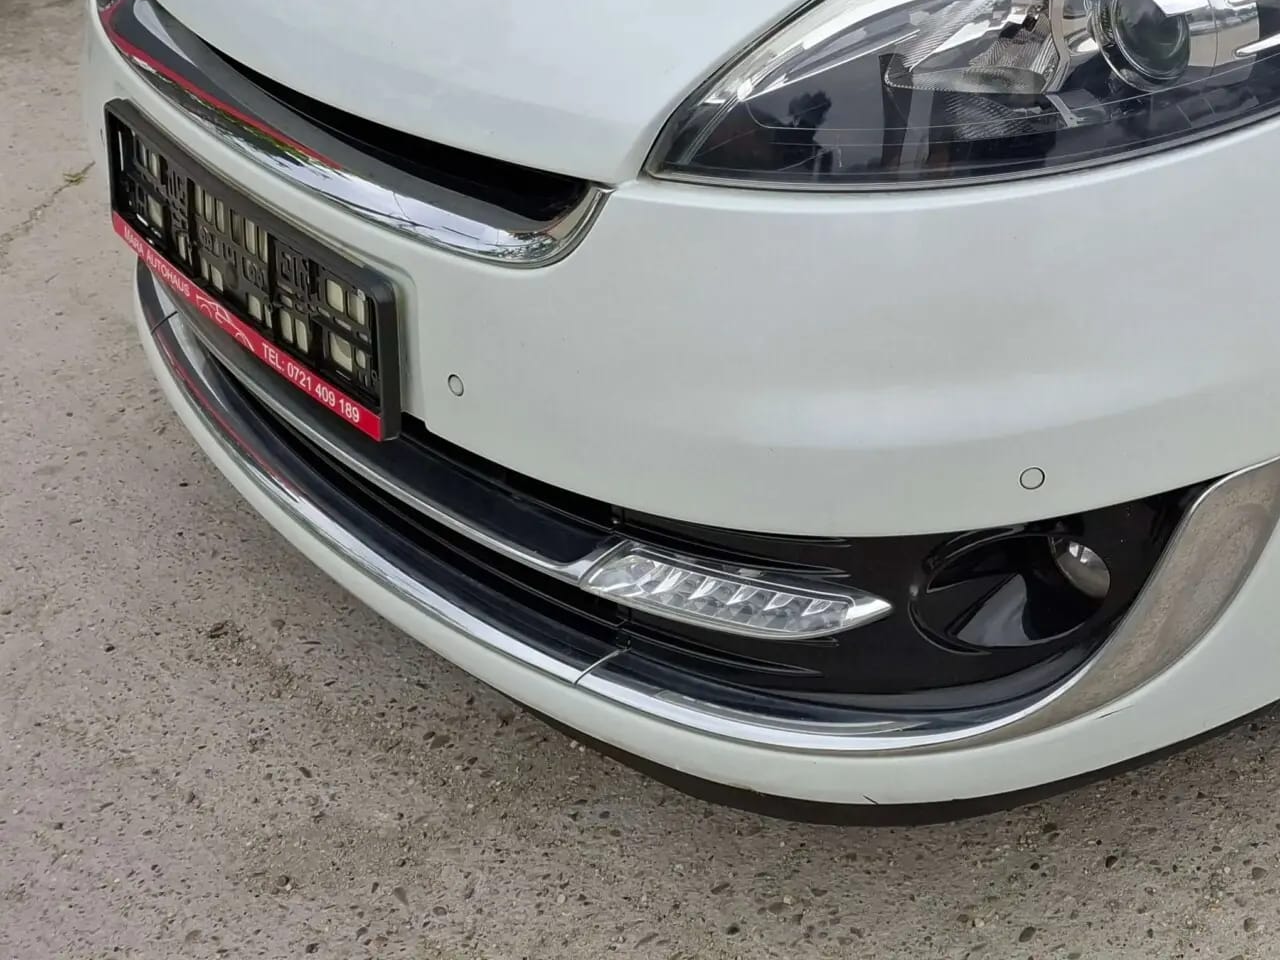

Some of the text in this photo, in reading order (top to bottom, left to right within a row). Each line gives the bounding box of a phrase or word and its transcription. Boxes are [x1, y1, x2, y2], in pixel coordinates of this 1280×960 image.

[146, 249, 190, 297] AUTOHAUS
[262, 342, 360, 423] TEL: 0721 409 189
